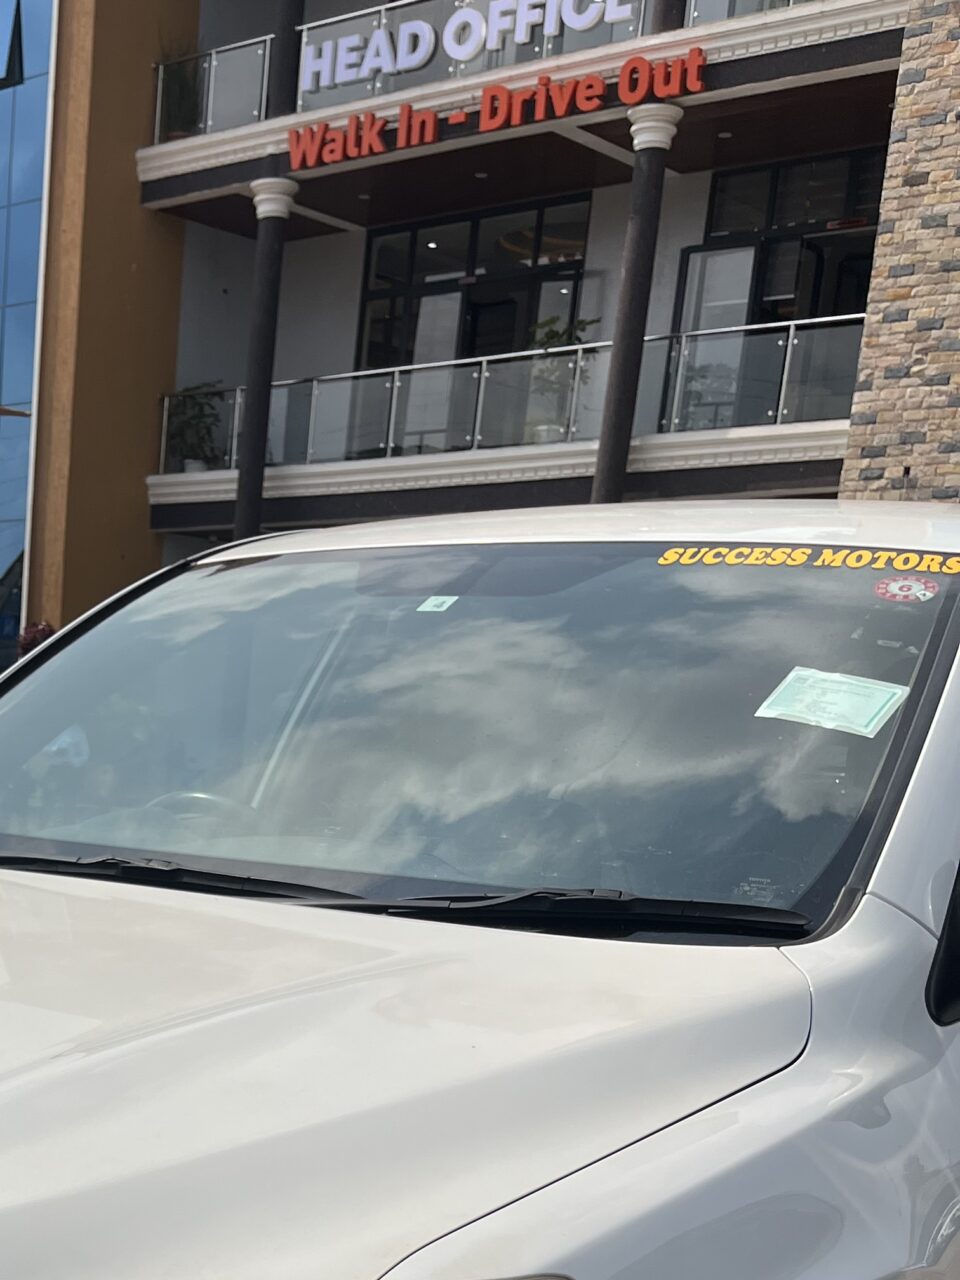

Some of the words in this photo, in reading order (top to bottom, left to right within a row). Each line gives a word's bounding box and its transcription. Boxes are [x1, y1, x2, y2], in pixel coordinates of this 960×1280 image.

[302, 19, 436, 91] HEAD
[288, 112, 387, 171] Walk
[396, 103, 438, 150] In
[479, 74, 605, 133] Drive
[618, 46, 707, 106] Out
[657, 547, 812, 567] SUCCESS
[813, 549, 960, 574] MOTORS
